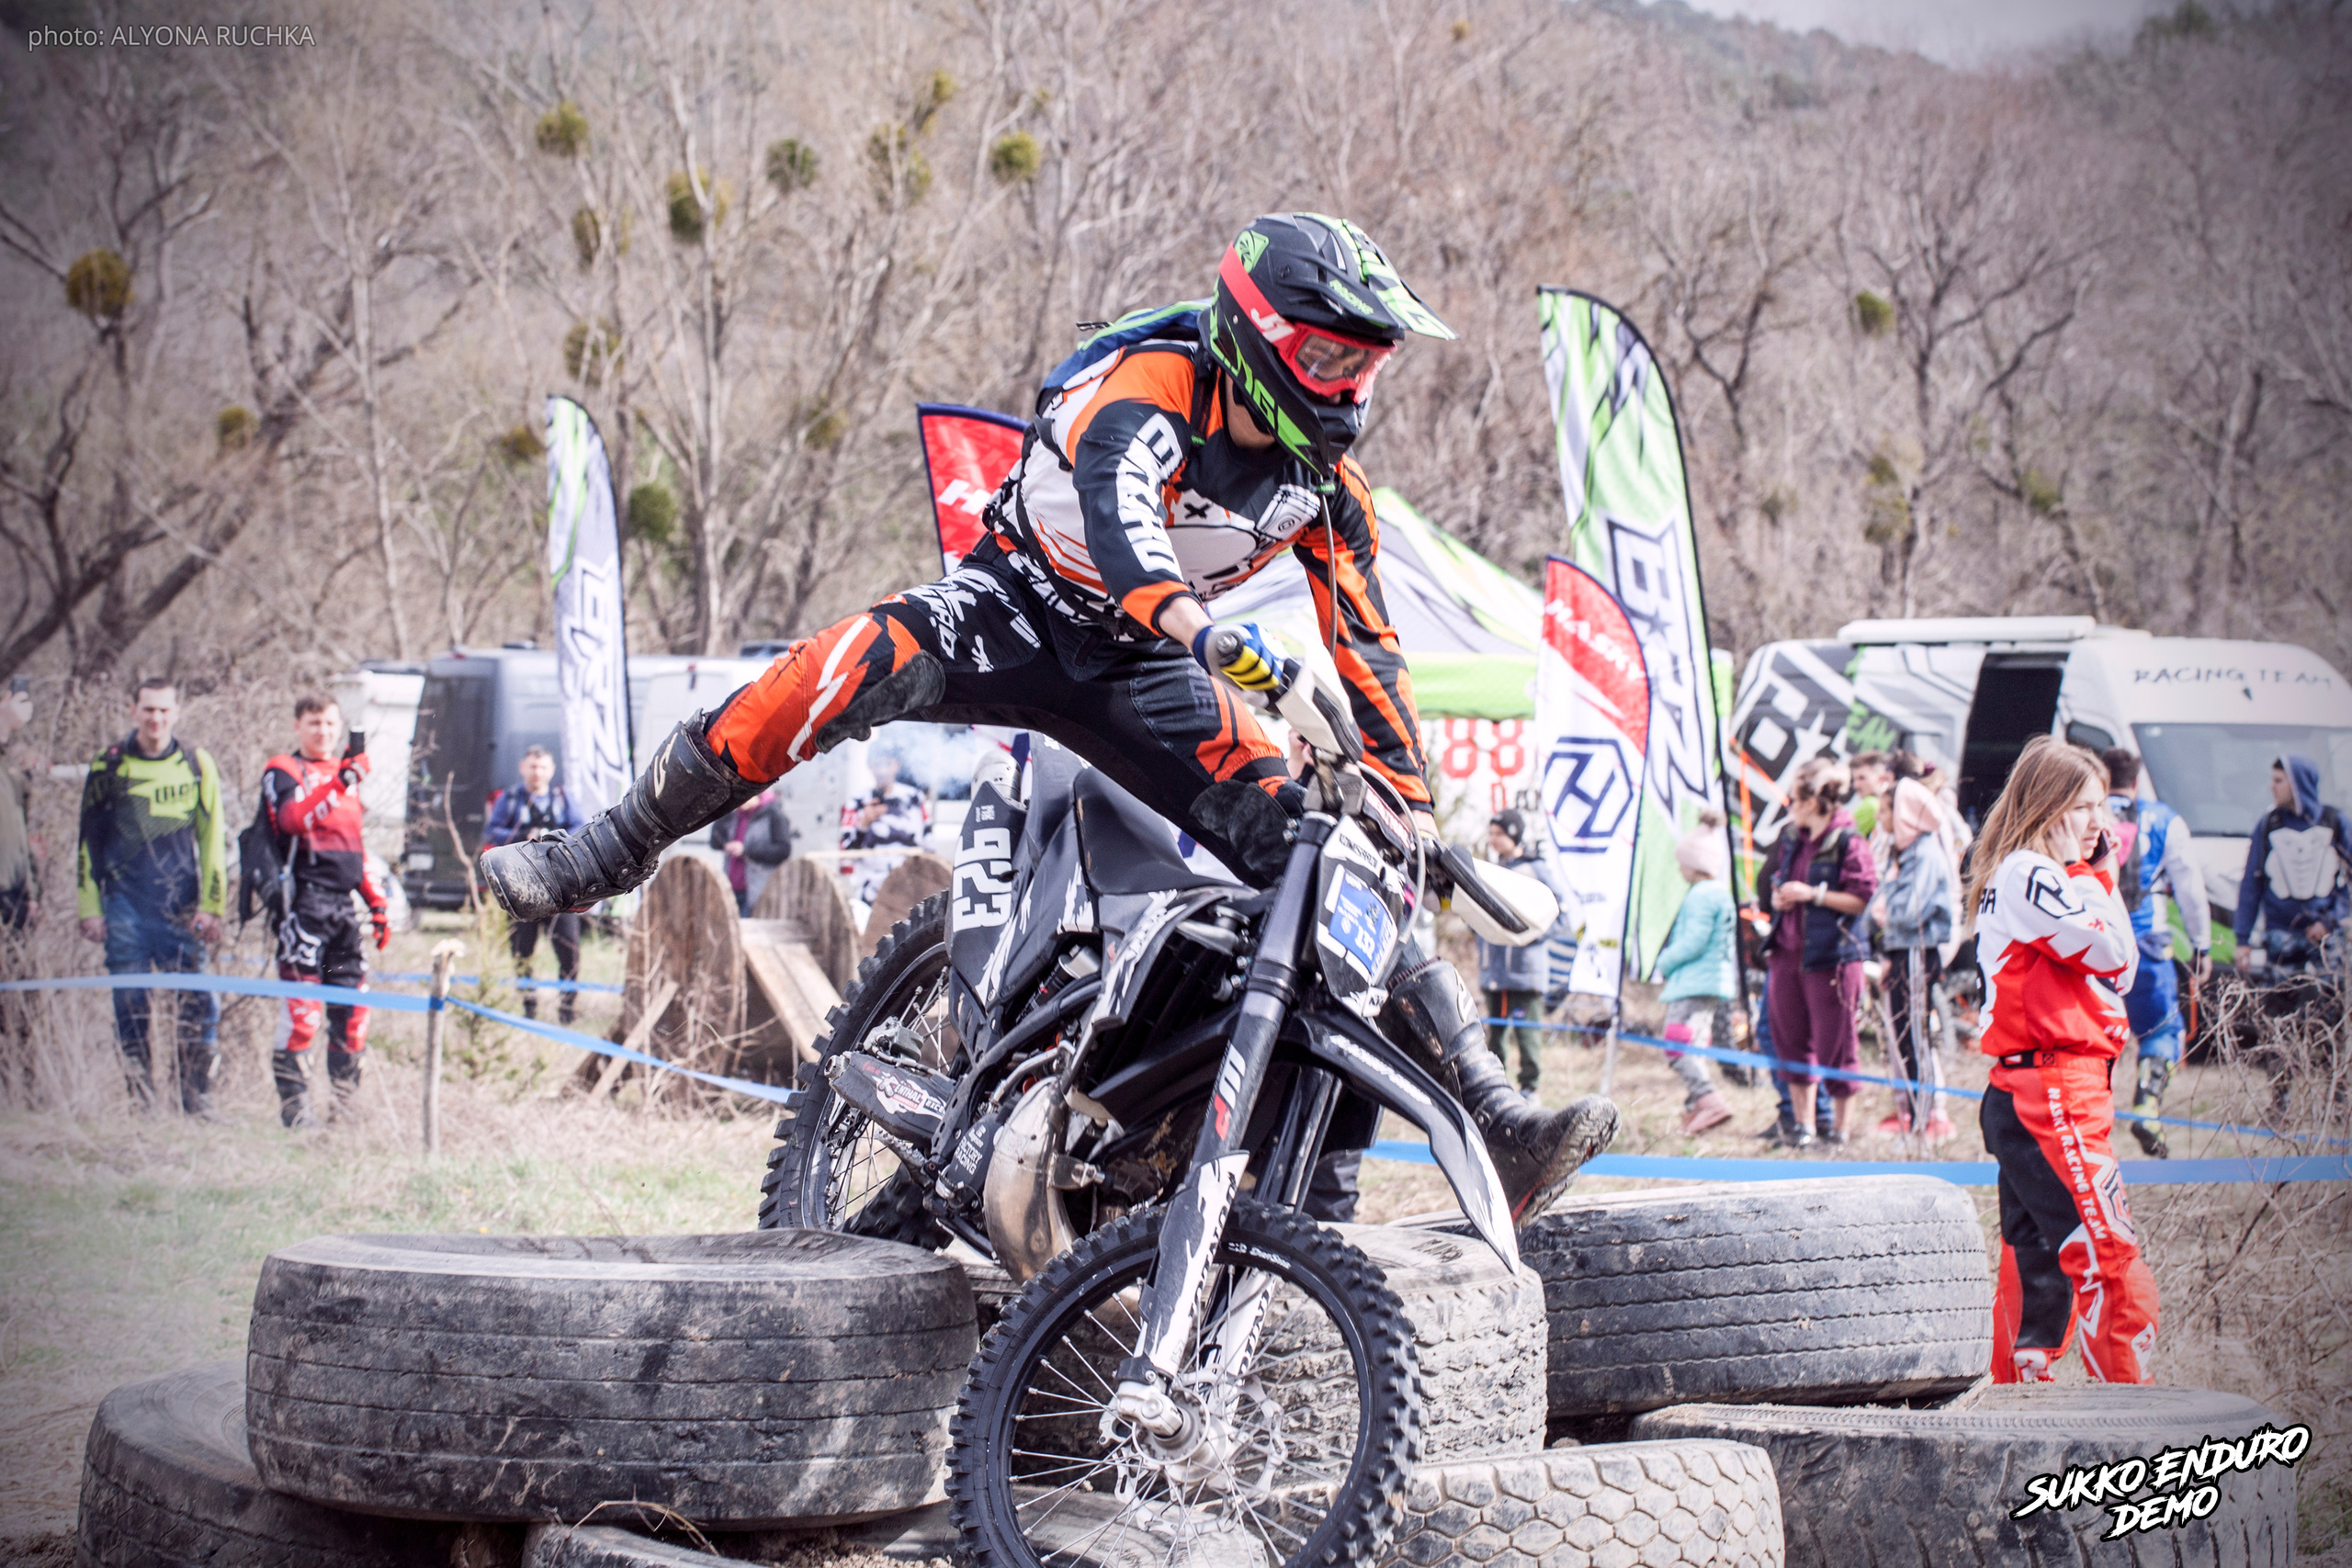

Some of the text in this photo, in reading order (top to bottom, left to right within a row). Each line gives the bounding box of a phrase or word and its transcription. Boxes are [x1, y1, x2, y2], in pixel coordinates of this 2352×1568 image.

[2134, 667, 2332, 689] RACING TEAM
[303, 788, 341, 829] FOX
[953, 828, 1012, 933] 923
[2061, 1134, 2090, 1193] RACING
[2081, 1197, 2108, 1239] TEAM
